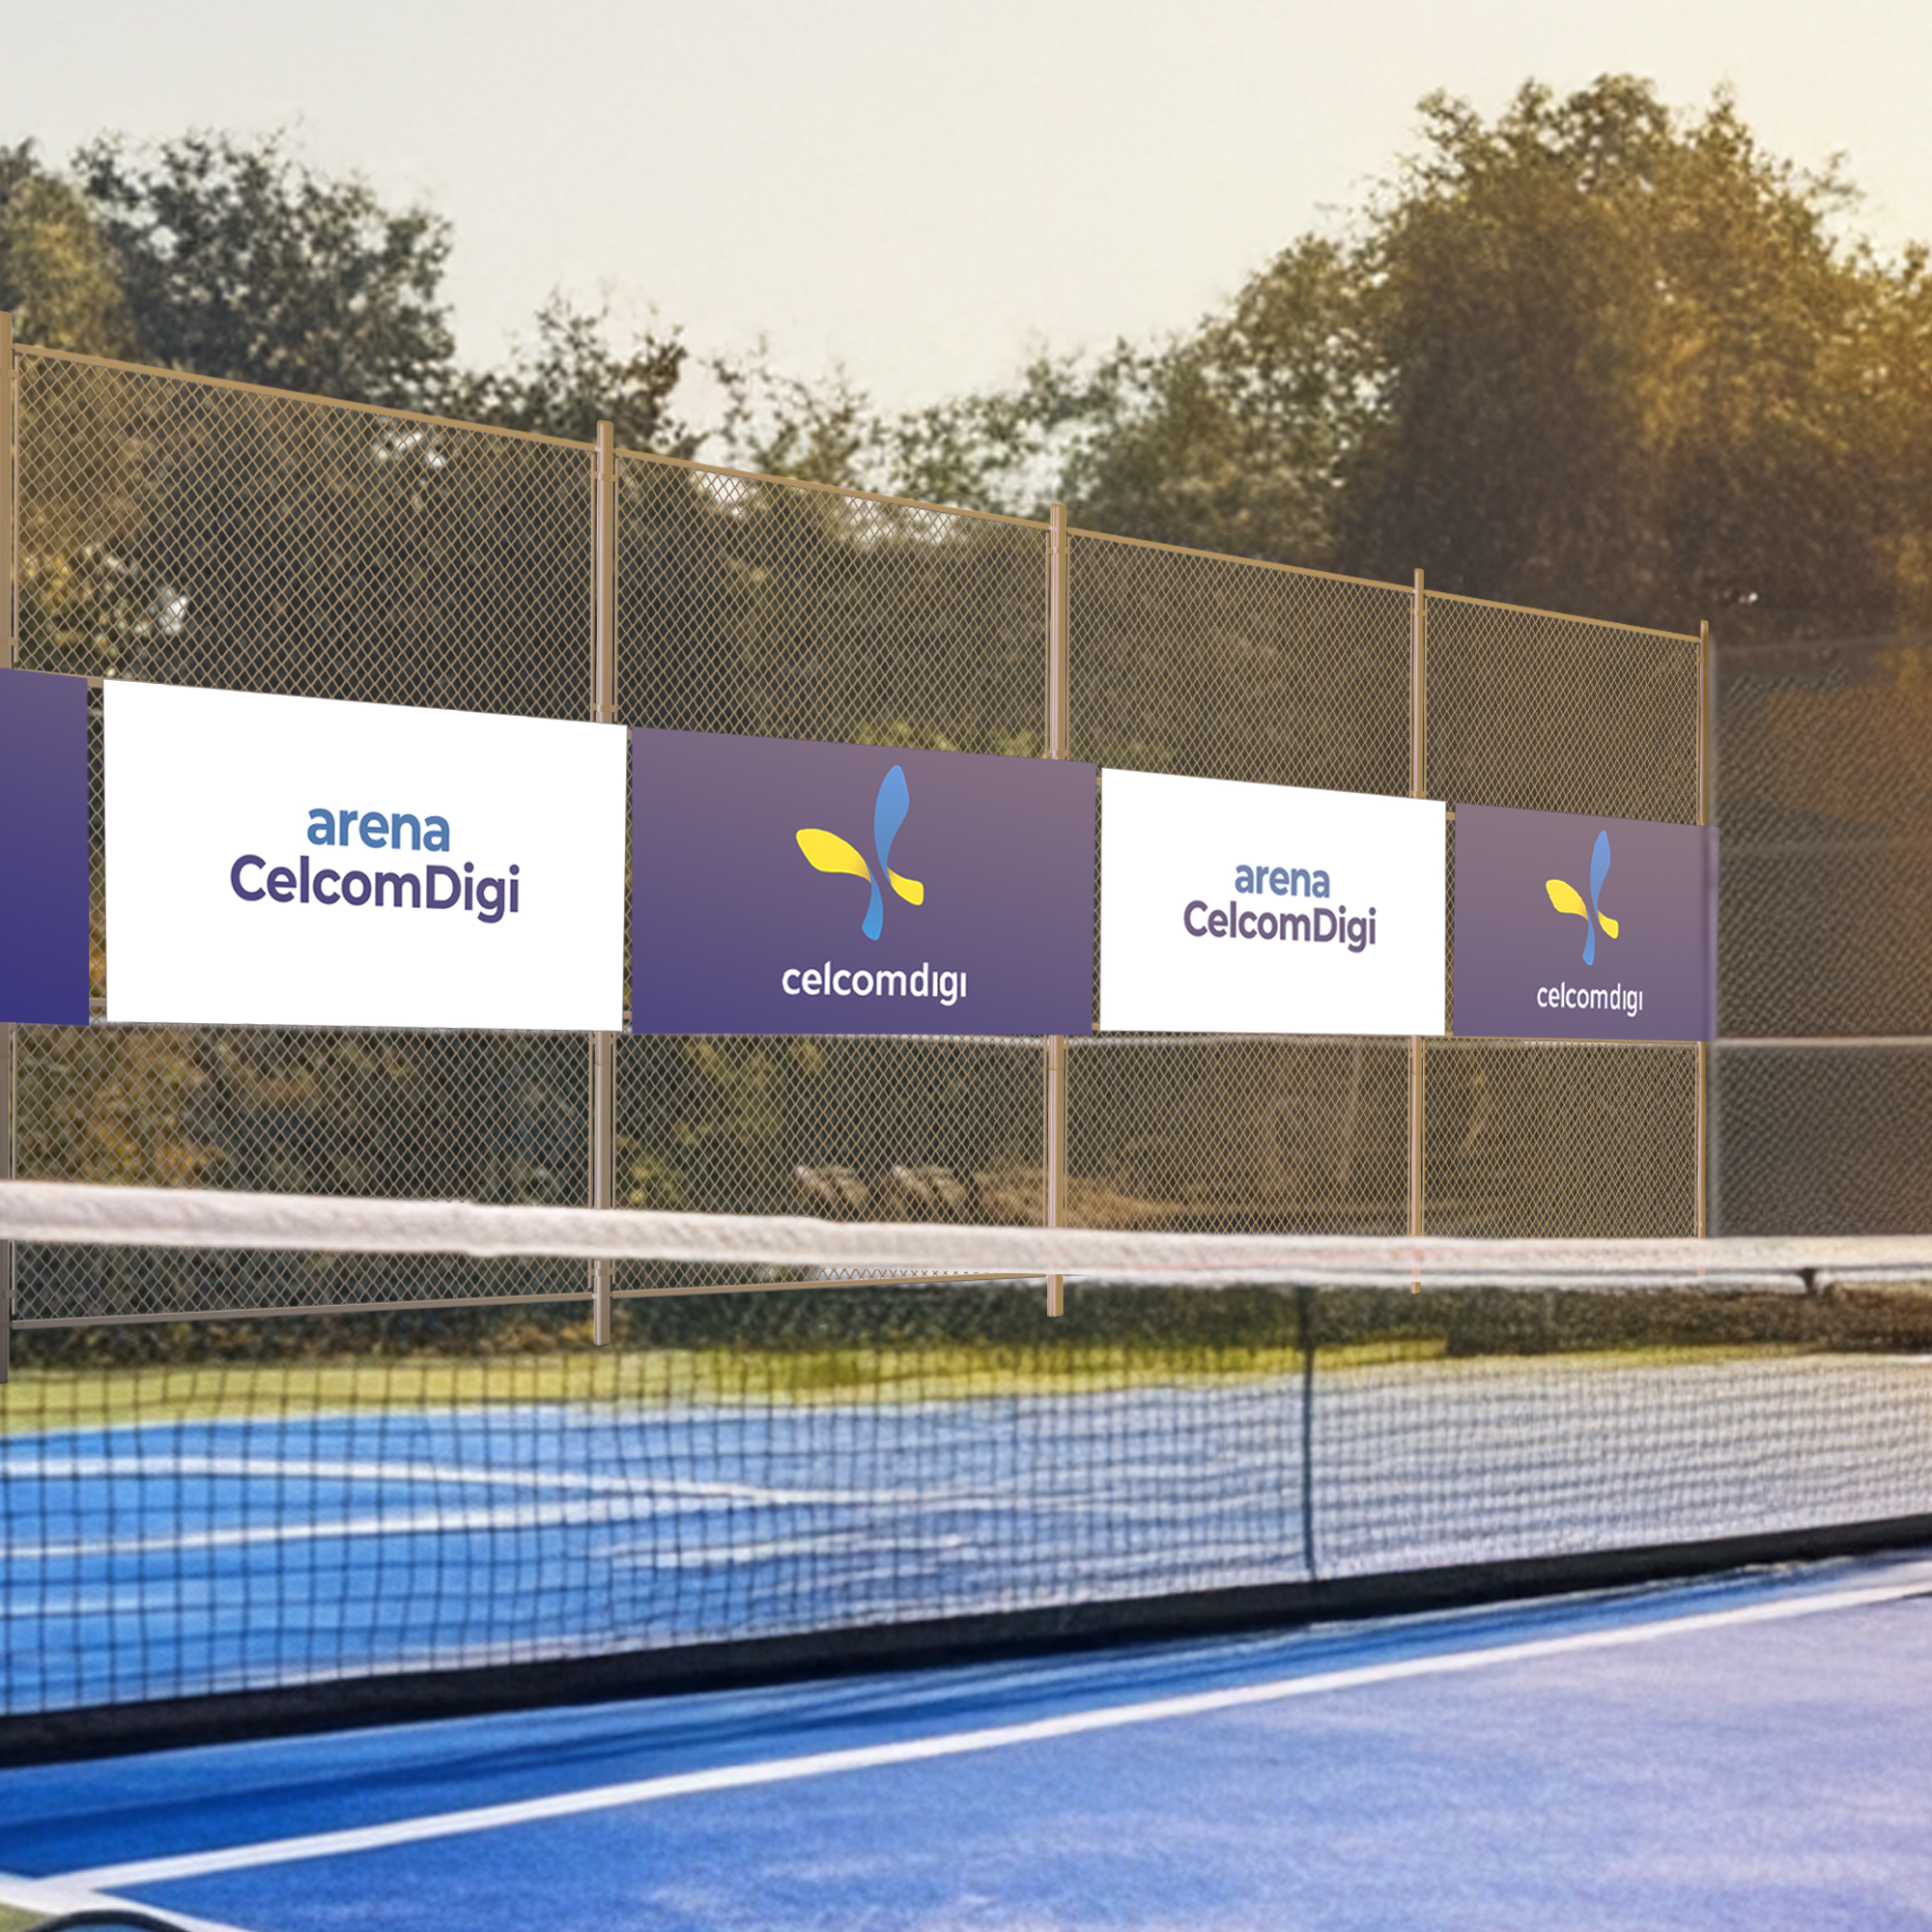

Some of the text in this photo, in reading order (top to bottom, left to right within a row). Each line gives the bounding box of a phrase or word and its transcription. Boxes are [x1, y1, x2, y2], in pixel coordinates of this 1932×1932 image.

[307, 808, 450, 852] arena
[230, 854, 520, 923] CelcomDigi
[1235, 865, 1330, 898] arena
[1183, 899, 1377, 953] CelcomDigi
